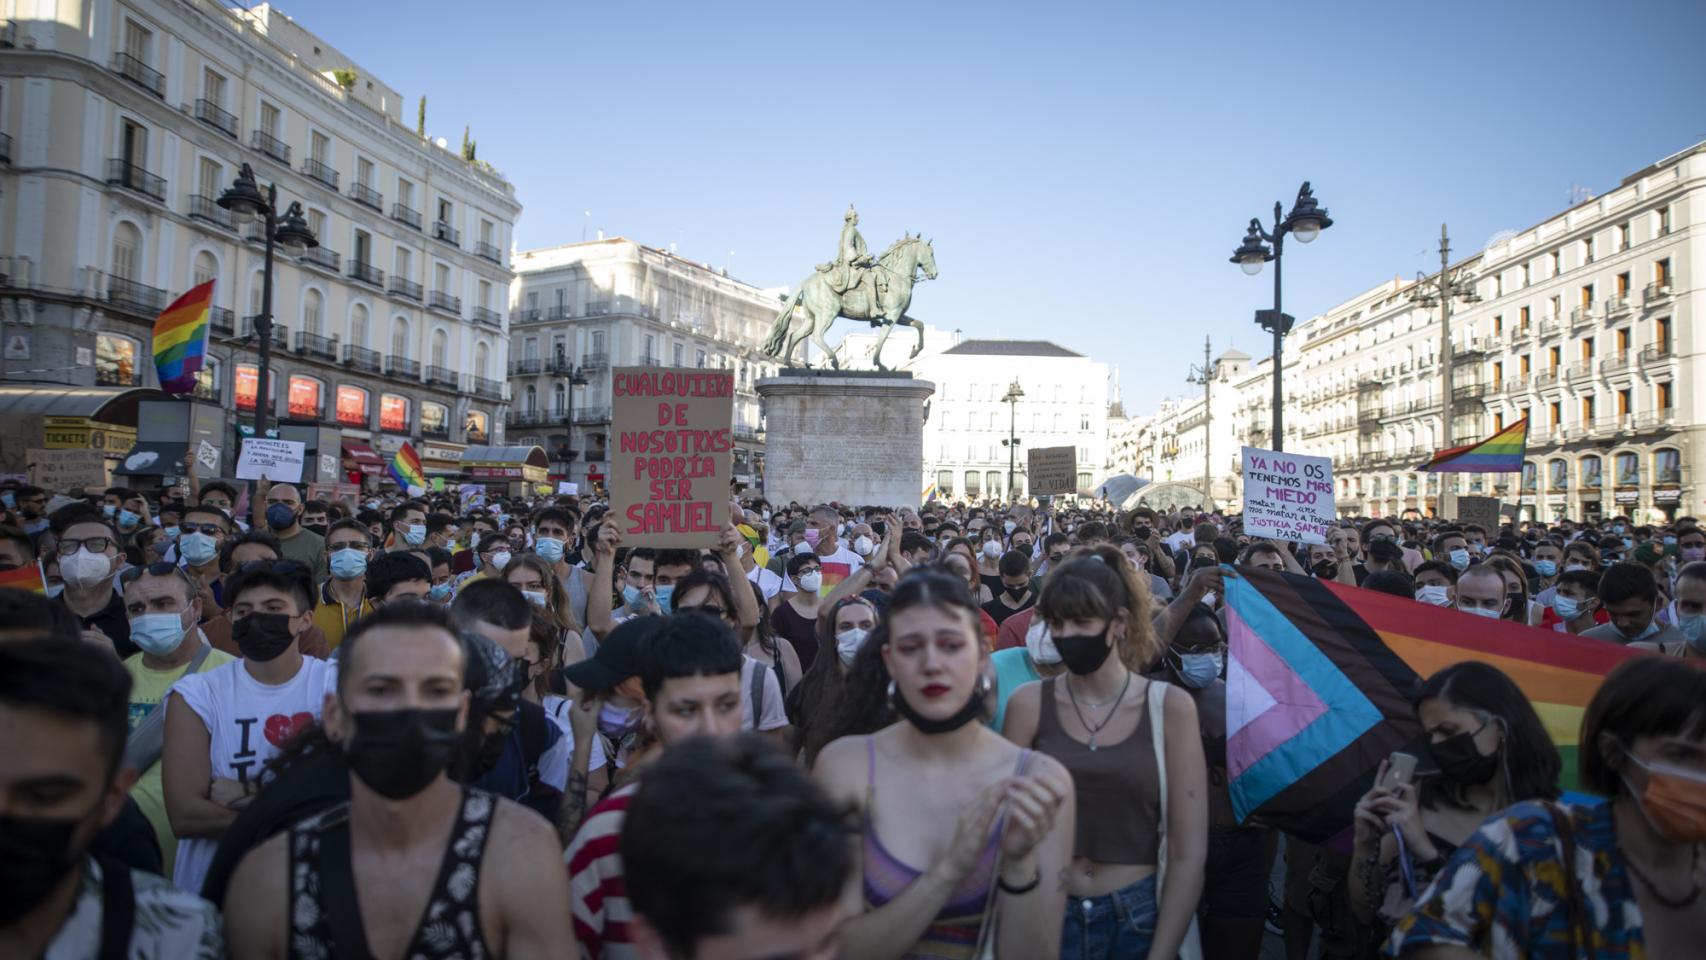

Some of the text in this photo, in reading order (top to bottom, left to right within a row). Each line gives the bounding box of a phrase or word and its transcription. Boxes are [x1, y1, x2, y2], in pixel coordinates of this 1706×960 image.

[613, 372, 734, 398] CUALQUIERA
[658, 402, 688, 426] DE
[46, 432, 87, 444] TICKETS
[620, 428, 730, 454] NOSOTRXS
[634, 453, 716, 481] PODRÍA
[1250, 456, 1324, 479] YA NO OS
[649, 478, 692, 501] SER
[1249, 471, 1301, 488] TENEMOS
[1266, 486, 1317, 505] MIEDO
[626, 501, 721, 534] SAMUEL
[1276, 528, 1303, 541] PARA
[234, 717, 259, 760] I
